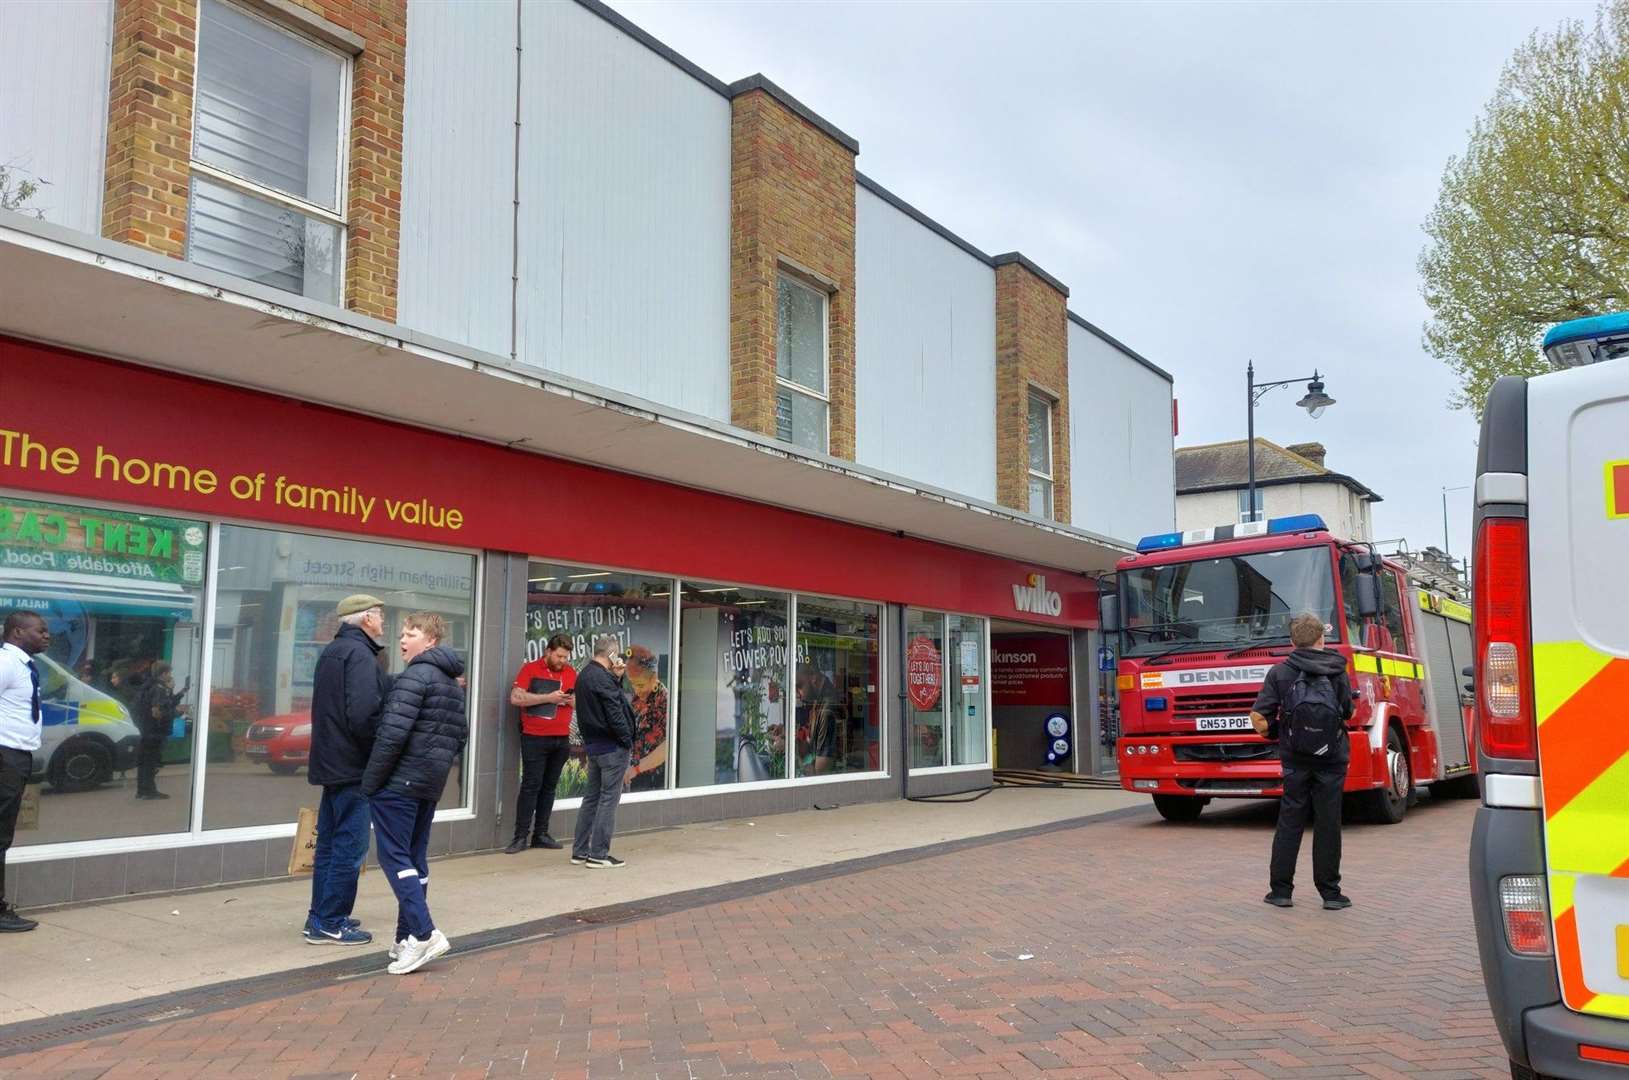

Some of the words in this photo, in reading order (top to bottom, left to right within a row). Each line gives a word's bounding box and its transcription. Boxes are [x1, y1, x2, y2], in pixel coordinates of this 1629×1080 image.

[0, 429, 80, 475] The
[95, 446, 218, 495] home
[230, 472, 266, 502] of
[275, 475, 376, 523] family
[385, 498, 465, 530] value
[1012, 573, 1062, 617] wilko
[547, 611, 569, 631] GET
[574, 608, 584, 629] IT
[588, 606, 603, 627] TO
[608, 606, 625, 626] ITS
[730, 627, 753, 648] LET'S
[724, 647, 767, 673] FLOWER
[1179, 668, 1265, 684] DENNIS
[1200, 719, 1227, 729] GN53
[1229, 718, 1249, 728] POF
